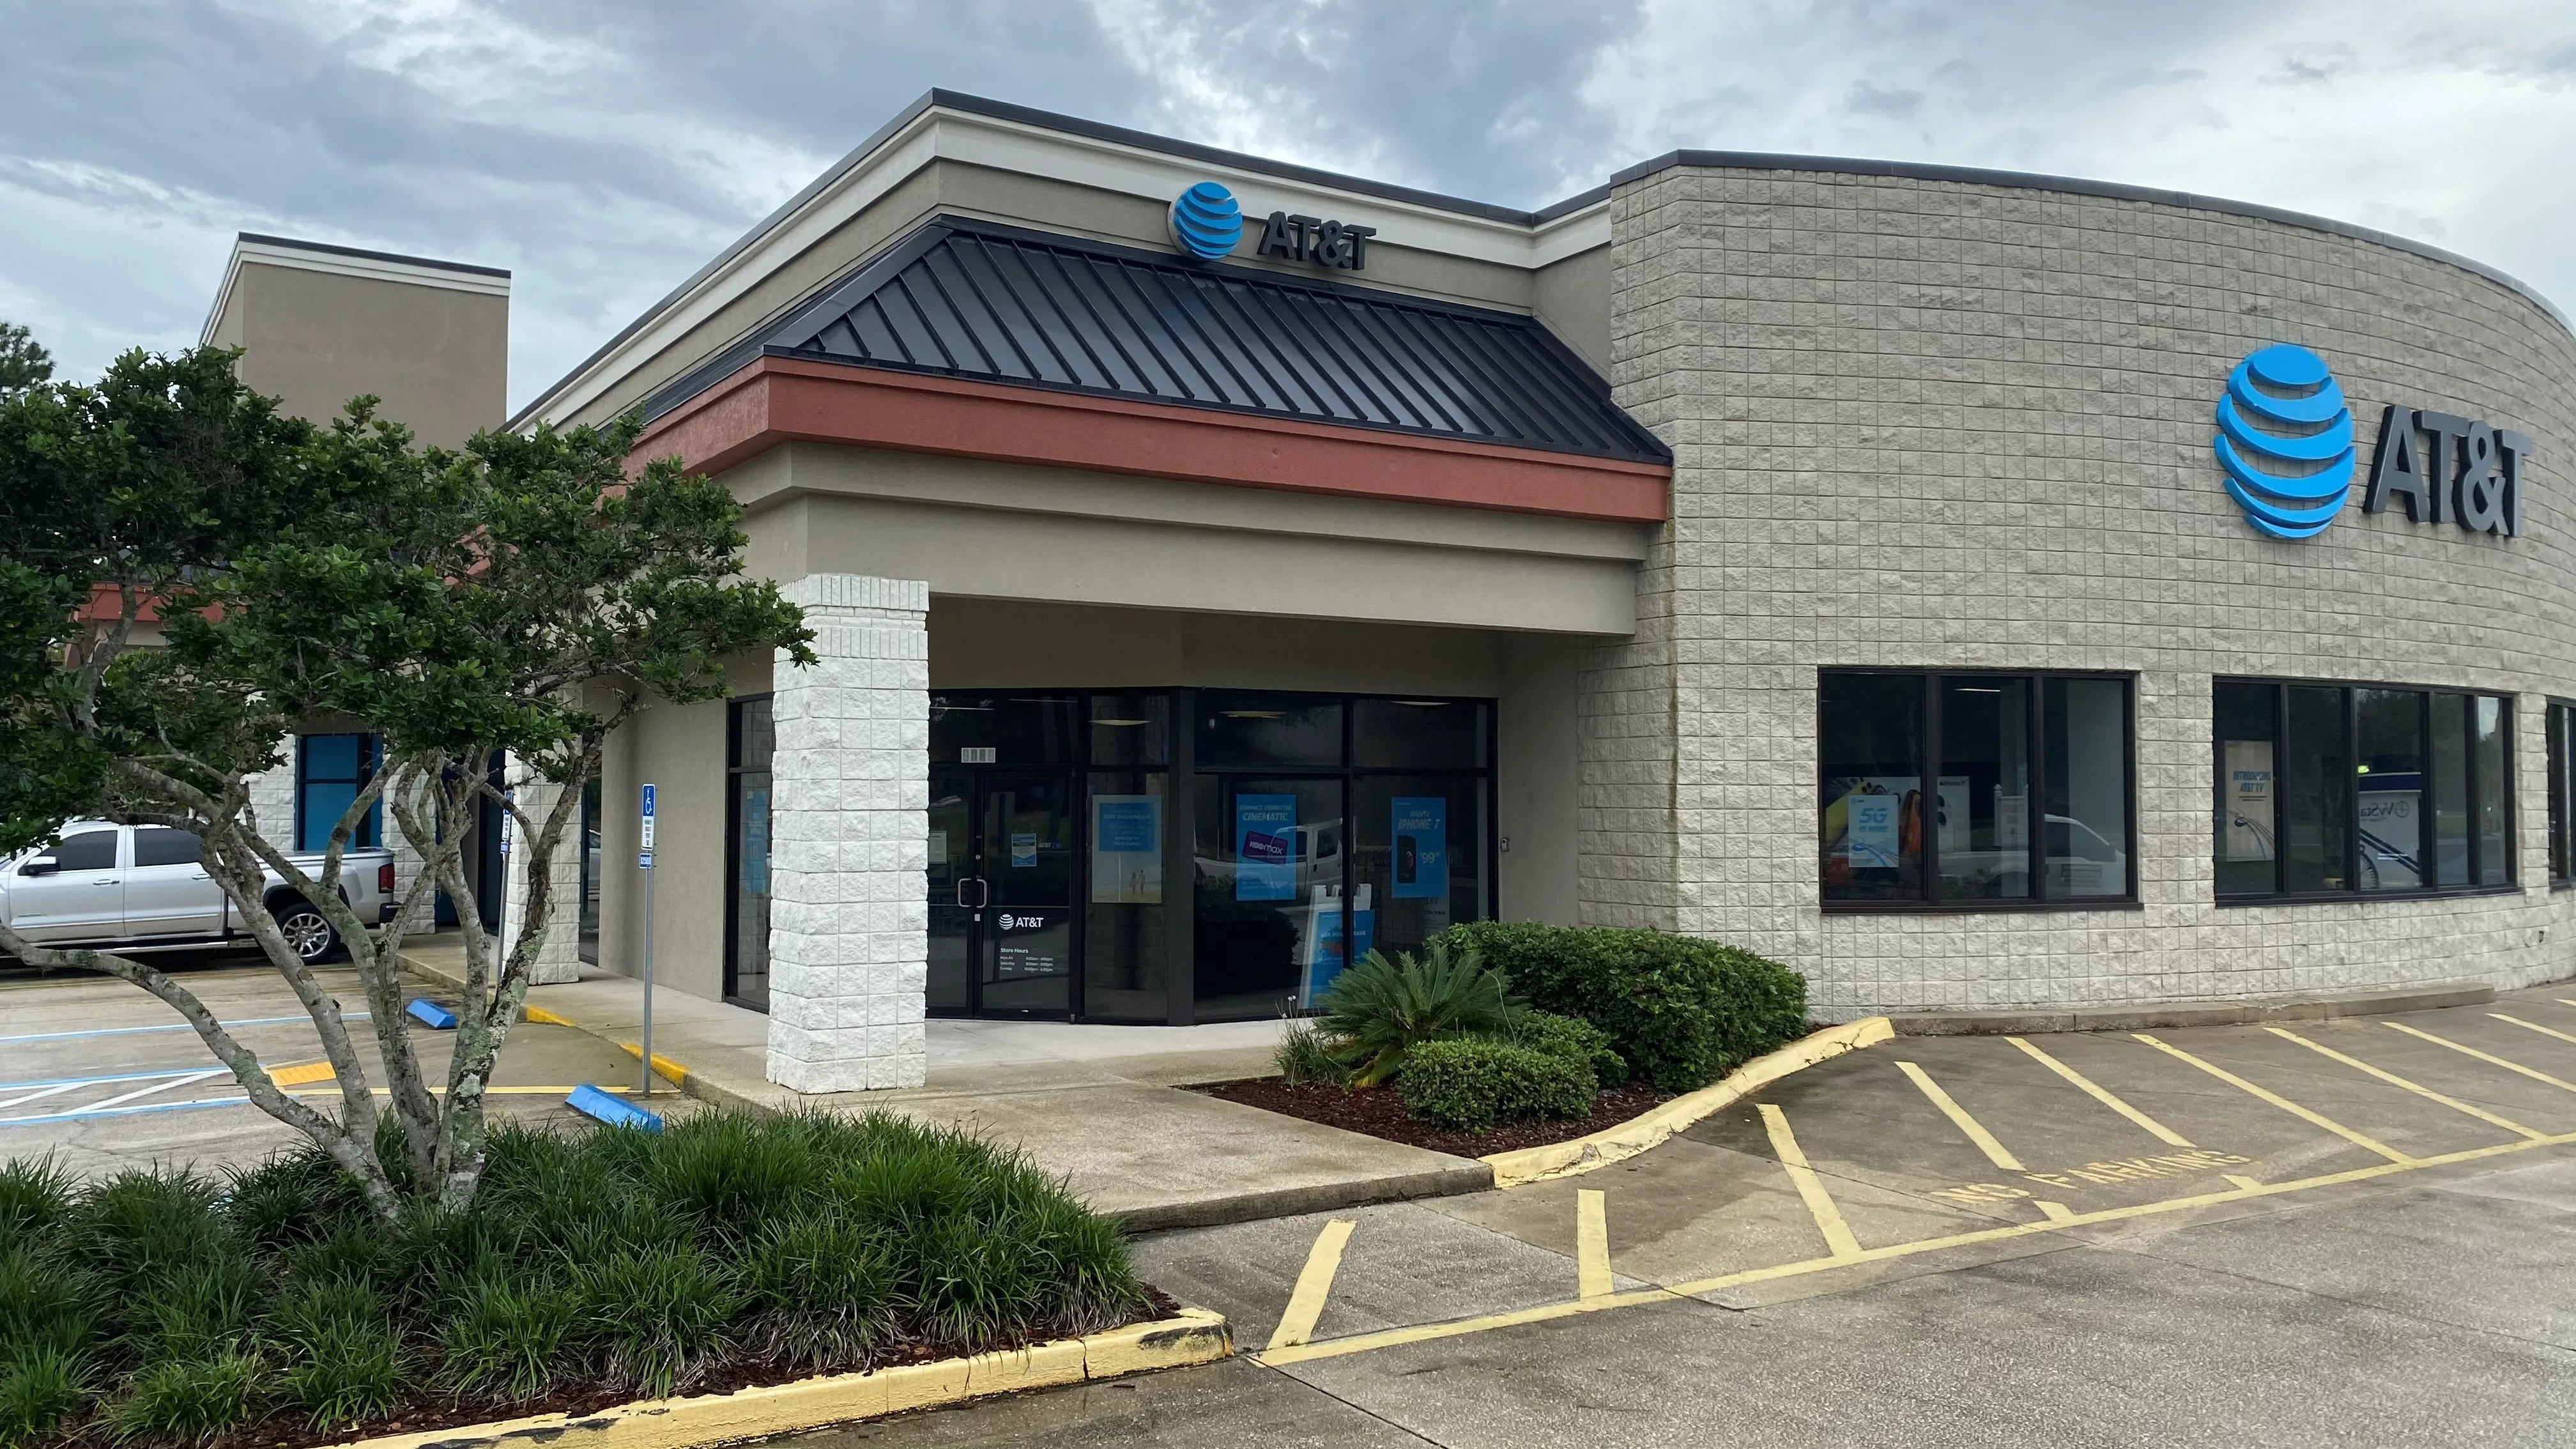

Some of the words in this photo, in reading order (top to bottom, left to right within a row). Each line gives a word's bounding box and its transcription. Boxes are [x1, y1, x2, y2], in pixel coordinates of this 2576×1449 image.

[1256, 211, 1377, 271] AT&T
[2362, 404, 2533, 538] AT&T
[1859, 808, 1888, 824] 5G
[1015, 917, 1044, 928] AT&T
[1930, 1183, 2032, 1206] NO
[2022, 1149, 2251, 1189] PARKING
